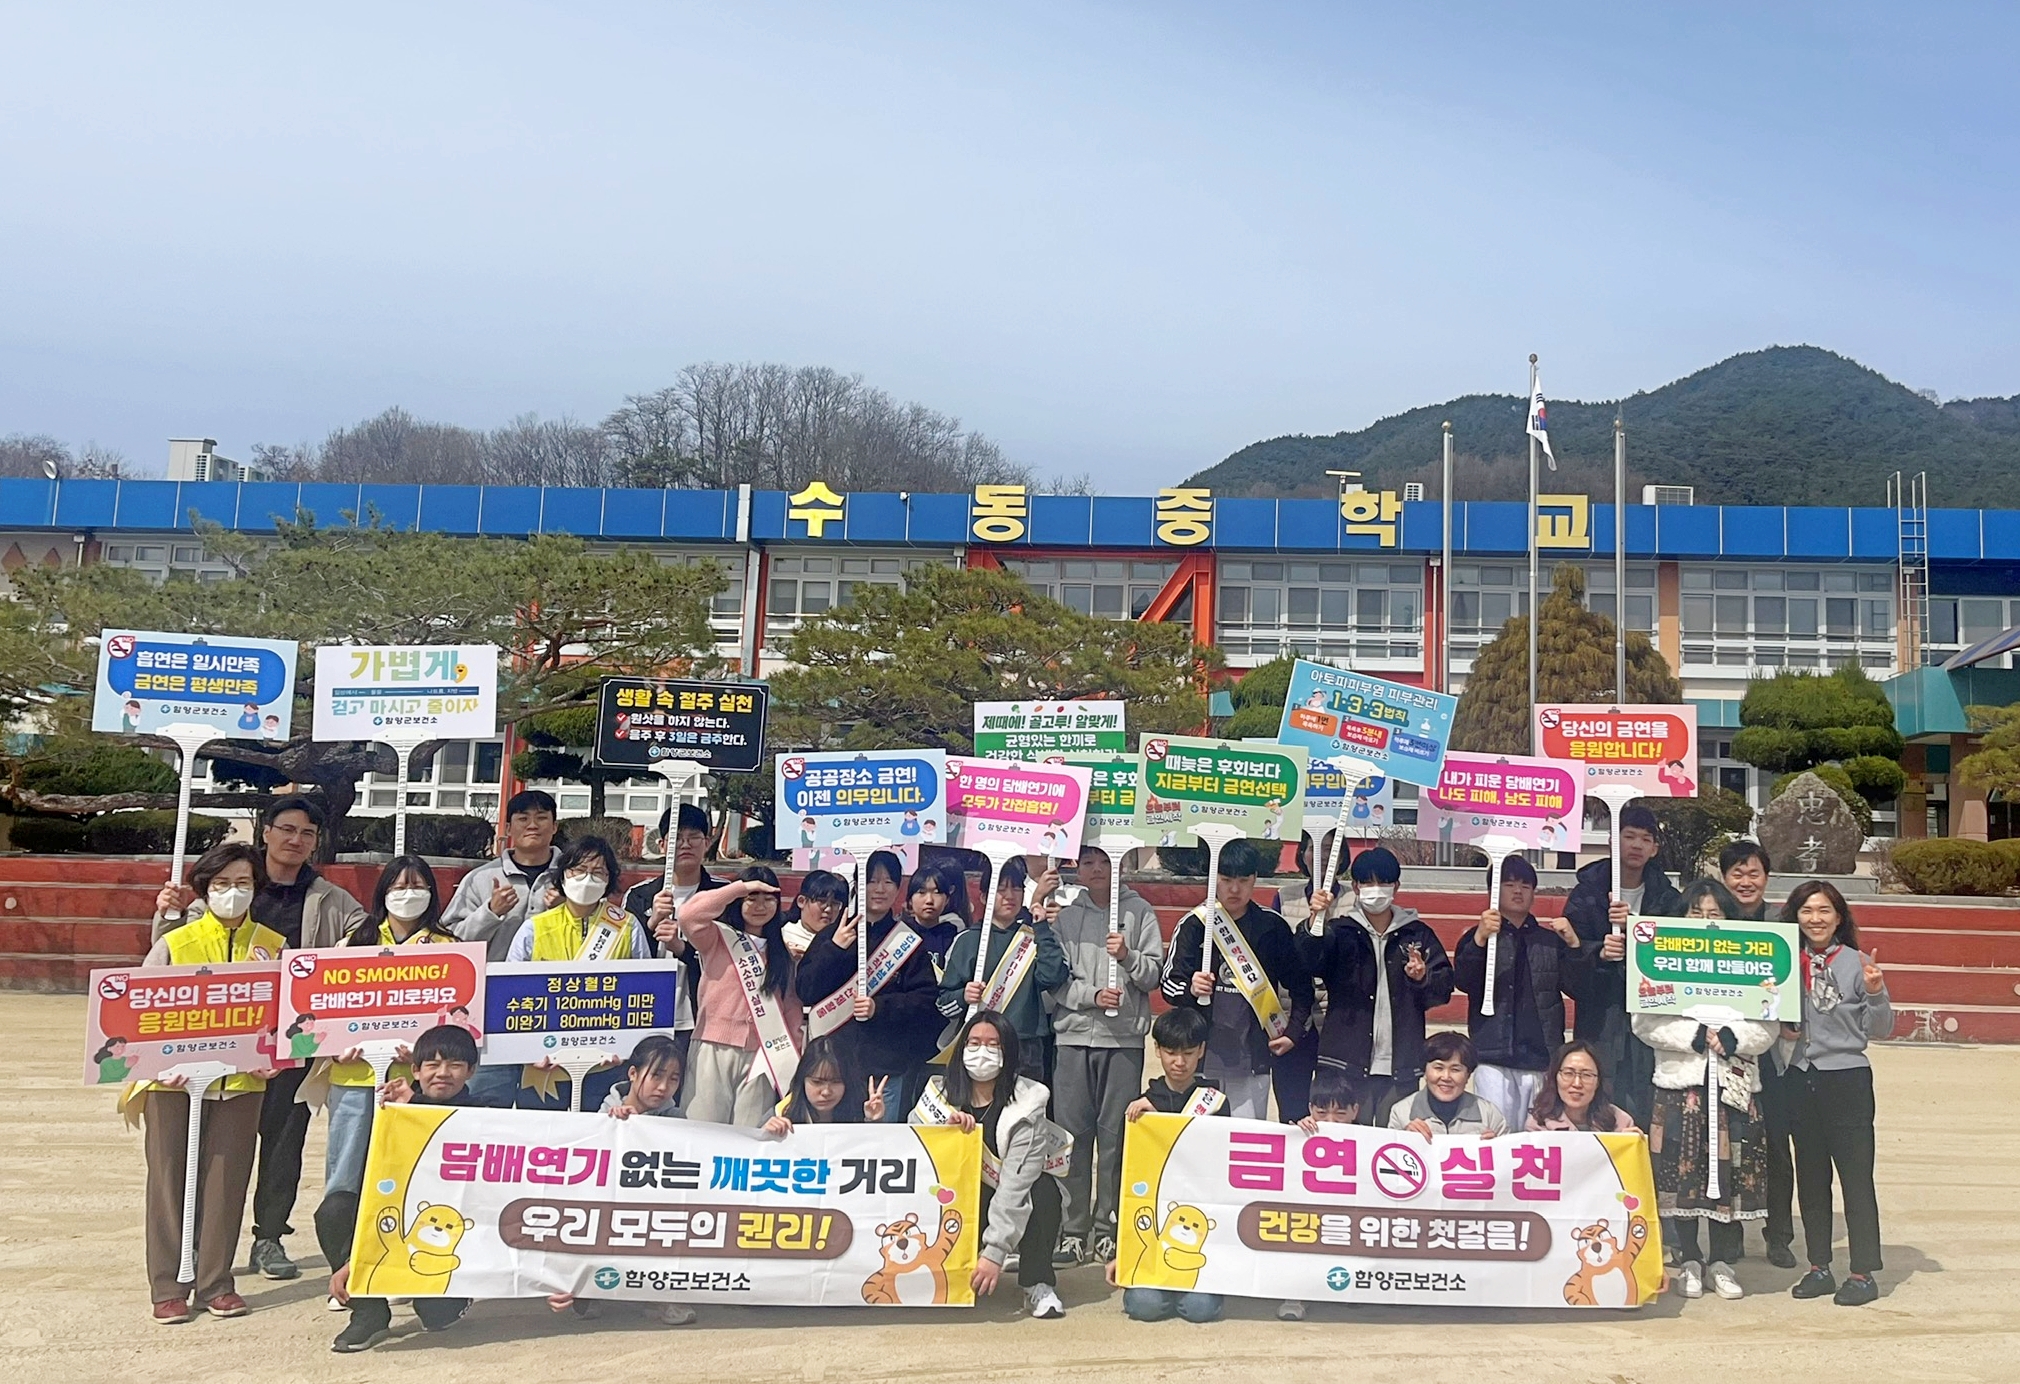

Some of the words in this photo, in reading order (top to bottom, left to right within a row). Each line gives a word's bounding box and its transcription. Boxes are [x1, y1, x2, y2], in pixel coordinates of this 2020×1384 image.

[136, 651, 188, 670] 흡연은
[193, 655, 259, 673] 일시만족
[134, 674, 186, 691] 금연은
[190, 677, 258, 695] 평생만족
[1310, 670, 1384, 697] 아토피피부염
[1388, 690, 1438, 710] 피부관리
[173, 706, 227, 715] 함양군보건소
[332, 700, 364, 715] 걷고
[370, 699, 420, 714] 마시고
[427, 698, 478, 714] 줄이자
[616, 688, 652, 707] 생활
[657, 693, 674, 708] 속
[679, 692, 713, 710] 절주
[719, 694, 753, 713] 실천
[631, 713, 664, 725] 원샷을
[668, 716, 690, 727] 하지
[693, 716, 730, 728] 않는다.
[982, 715, 1026, 729] 제때에!
[1029, 715, 1072, 729] 골고루!
[1076, 715, 1117, 728] 알맞게!
[1562, 721, 1611, 738] 당신의
[1617, 721, 1668, 738] 금연을
[629, 730, 651, 741] 음주
[654, 731, 665, 741] 후
[668, 732, 697, 744] 3일은
[700, 733, 747, 746] 금주한다.
[1005, 735, 1055, 747] 균형있는
[1059, 734, 1096, 747] 한끼로
[1342, 743, 1389, 760] 함양군보건소
[1570, 741, 1662, 758] 응원합니다!
[805, 768, 872, 787] 공공장소
[878, 767, 917, 784] 금연!
[1165, 755, 1212, 773] 때늦은
[1217, 760, 1281, 779] 후회보다
[959, 775, 972, 789] 한
[975, 777, 1000, 791] 명의
[1002, 779, 1066, 798] 담배연기에
[1155, 772, 1219, 793] 지금부터
[1224, 778, 1287, 798] 금연선택
[1444, 771, 1472, 785] 내가
[1475, 773, 1501, 788] 피운
[1505, 776, 1559, 793] 담배연기
[797, 790, 831, 806] 이젠
[836, 787, 925, 805] 의무입니다.
[961, 794, 999, 810] 모두가
[1002, 798, 1058, 815] 간접흡연!
[1439, 788, 1466, 801] 나도
[1470, 789, 1500, 805] 피해,
[1505, 792, 1531, 806] 남도
[1536, 795, 1562, 809] 피해
[844, 817, 891, 825] 함양군보건소
[1201, 806, 1247, 816] 함양군보건소
[988, 824, 1030, 834] 함양군보건소
[1482, 818, 1527, 828] 함양군보건소
[893, 934, 916, 960] 건강한
[1213, 911, 1223, 925] 리
[1231, 946, 1258, 983] 약속해요
[1654, 937, 1709, 953] 담배연기
[1713, 939, 1741, 955] 없는
[1745, 941, 1772, 956] 거리
[323, 969, 351, 985] NO
[355, 963, 449, 983] SMOKING!
[1654, 957, 1682, 971] 우리
[1685, 958, 1713, 973] 함께
[1717, 960, 1773, 976] 만들어요
[547, 976, 617, 993] 정상혈압
[739, 958, 756, 991] 소소한
[751, 994, 765, 1017] 실천
[1695, 988, 1743, 997] 함양군보건소
[129, 985, 199, 1009] 당신의
[206, 981, 273, 1005] 금연을
[310, 990, 381, 1010] 담배연기
[386, 987, 456, 1006] 괴로워요
[506, 997, 548, 1012] 수축기
[555, 996, 621, 1011] 120mmHg
[628, 993, 655, 1009] 미만
[816, 986, 855, 1018] 신체활동
[138, 1005, 265, 1034] 응원합니다!
[361, 1020, 419, 1030] 함양군보건소
[506, 1015, 547, 1031] 이완기
[560, 1014, 621, 1029] 80mmHg
[627, 1011, 654, 1027] 미만
[177, 1041, 237, 1052] 함양군보건소
[561, 1036, 616, 1046] 함양군보건소
[441, 1142, 613, 1187] 담배연기
[618, 1150, 701, 1189] 없는
[710, 1154, 831, 1196] 깨끗한
[839, 1158, 916, 1194] 거리
[1228, 1131, 1357, 1195] 금연
[1440, 1144, 1563, 1201] 실천
[519, 1209, 599, 1247] 우리
[607, 1211, 725, 1250] 모두의
[735, 1213, 830, 1251] 권리!
[1259, 1211, 1351, 1246] 건강을
[1360, 1216, 1421, 1250] 위한
[1427, 1218, 1528, 1252] 첫걸음!
[625, 1269, 751, 1292] 함양군보건소
[1355, 1269, 1466, 1293] 함양군보건소
